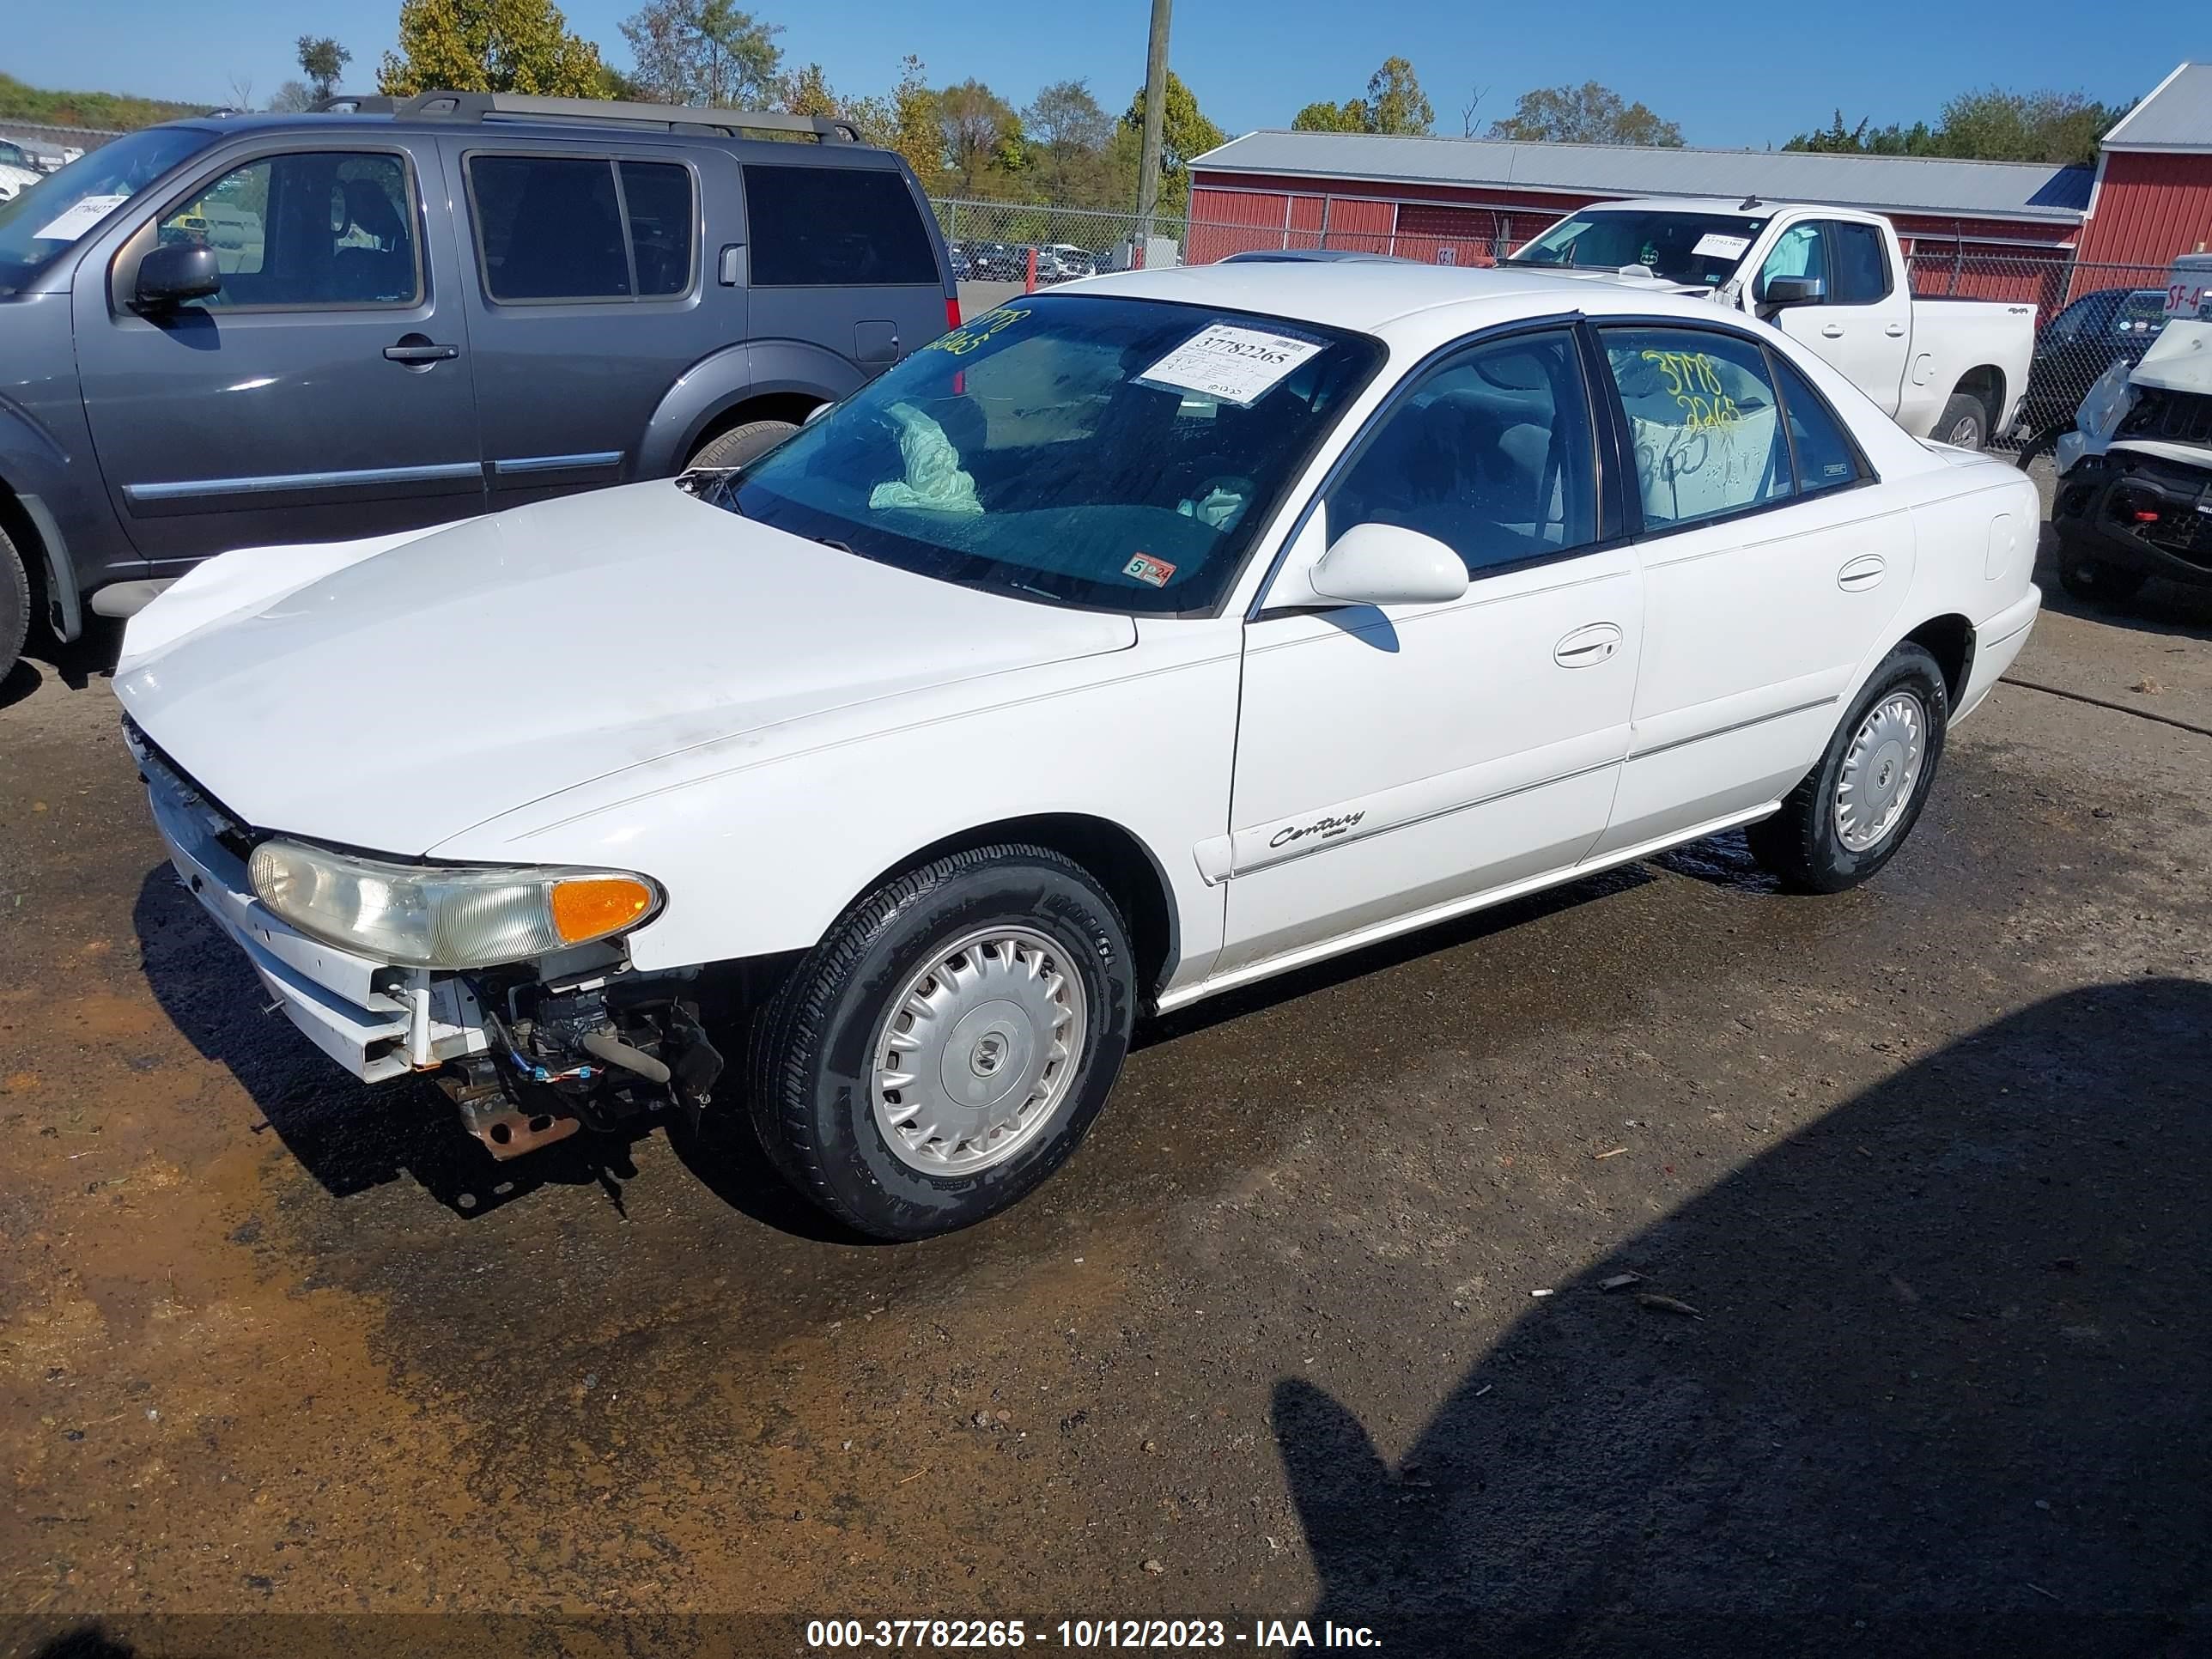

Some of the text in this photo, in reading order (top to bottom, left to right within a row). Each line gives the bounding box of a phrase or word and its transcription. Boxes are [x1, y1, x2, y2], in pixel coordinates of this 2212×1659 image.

[2165, 285, 2201, 311] SF-4
[1195, 337, 1291, 366] 37782265
[1641, 349, 1722, 396] 3778
[1677, 395, 1743, 434] 2265
[1130, 560, 1145, 573] 5
[1155, 568, 1170, 580] 24
[1269, 811, 1366, 848] Century
